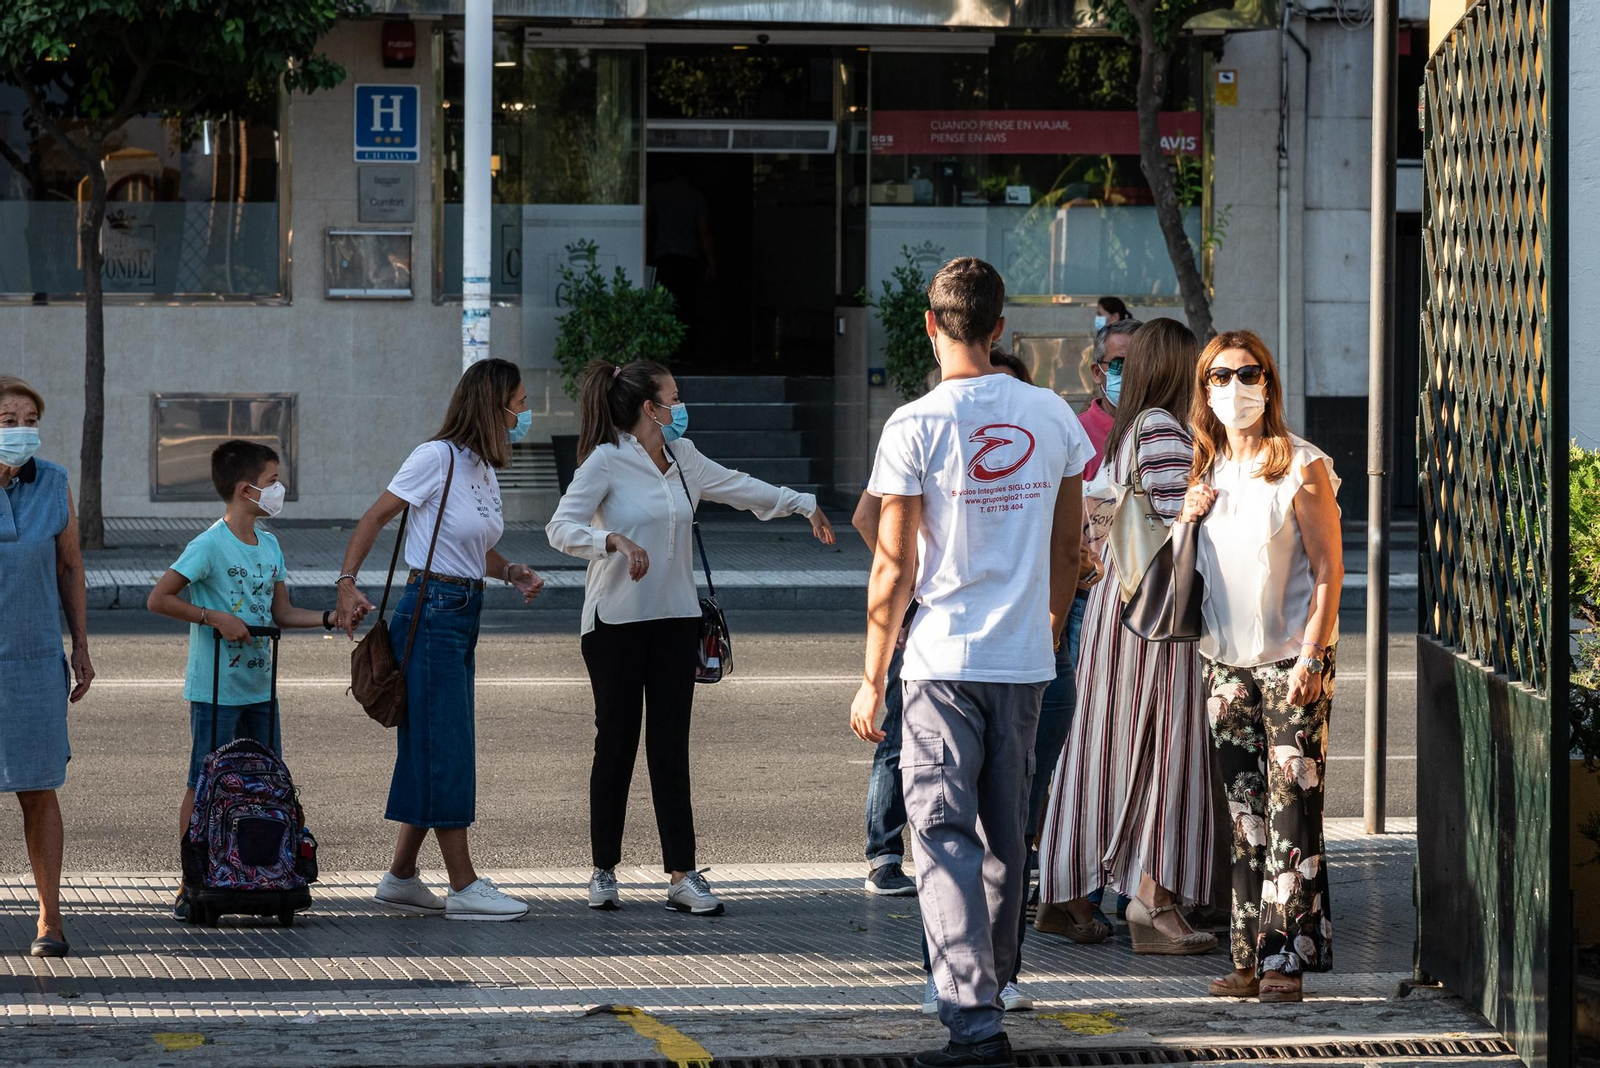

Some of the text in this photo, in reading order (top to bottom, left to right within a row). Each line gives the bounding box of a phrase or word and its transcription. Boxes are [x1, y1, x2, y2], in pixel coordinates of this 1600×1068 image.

[387, 40, 413, 48] FUEGO
[370, 94, 404, 132] H
[930, 120, 1072, 132] CUANDO PIENSE EN VIAJAR,
[930, 132, 1007, 143] PIENSE EN AVIS
[1160, 135, 1196, 151] AVIS
[369, 197, 405, 207] Comfort
[99, 247, 151, 280] ONDE
[1008, 482, 1031, 492] SIGLO
[964, 492, 1041, 505] www.gruposiglo21.com
[1010, 503, 1023, 511] 404
